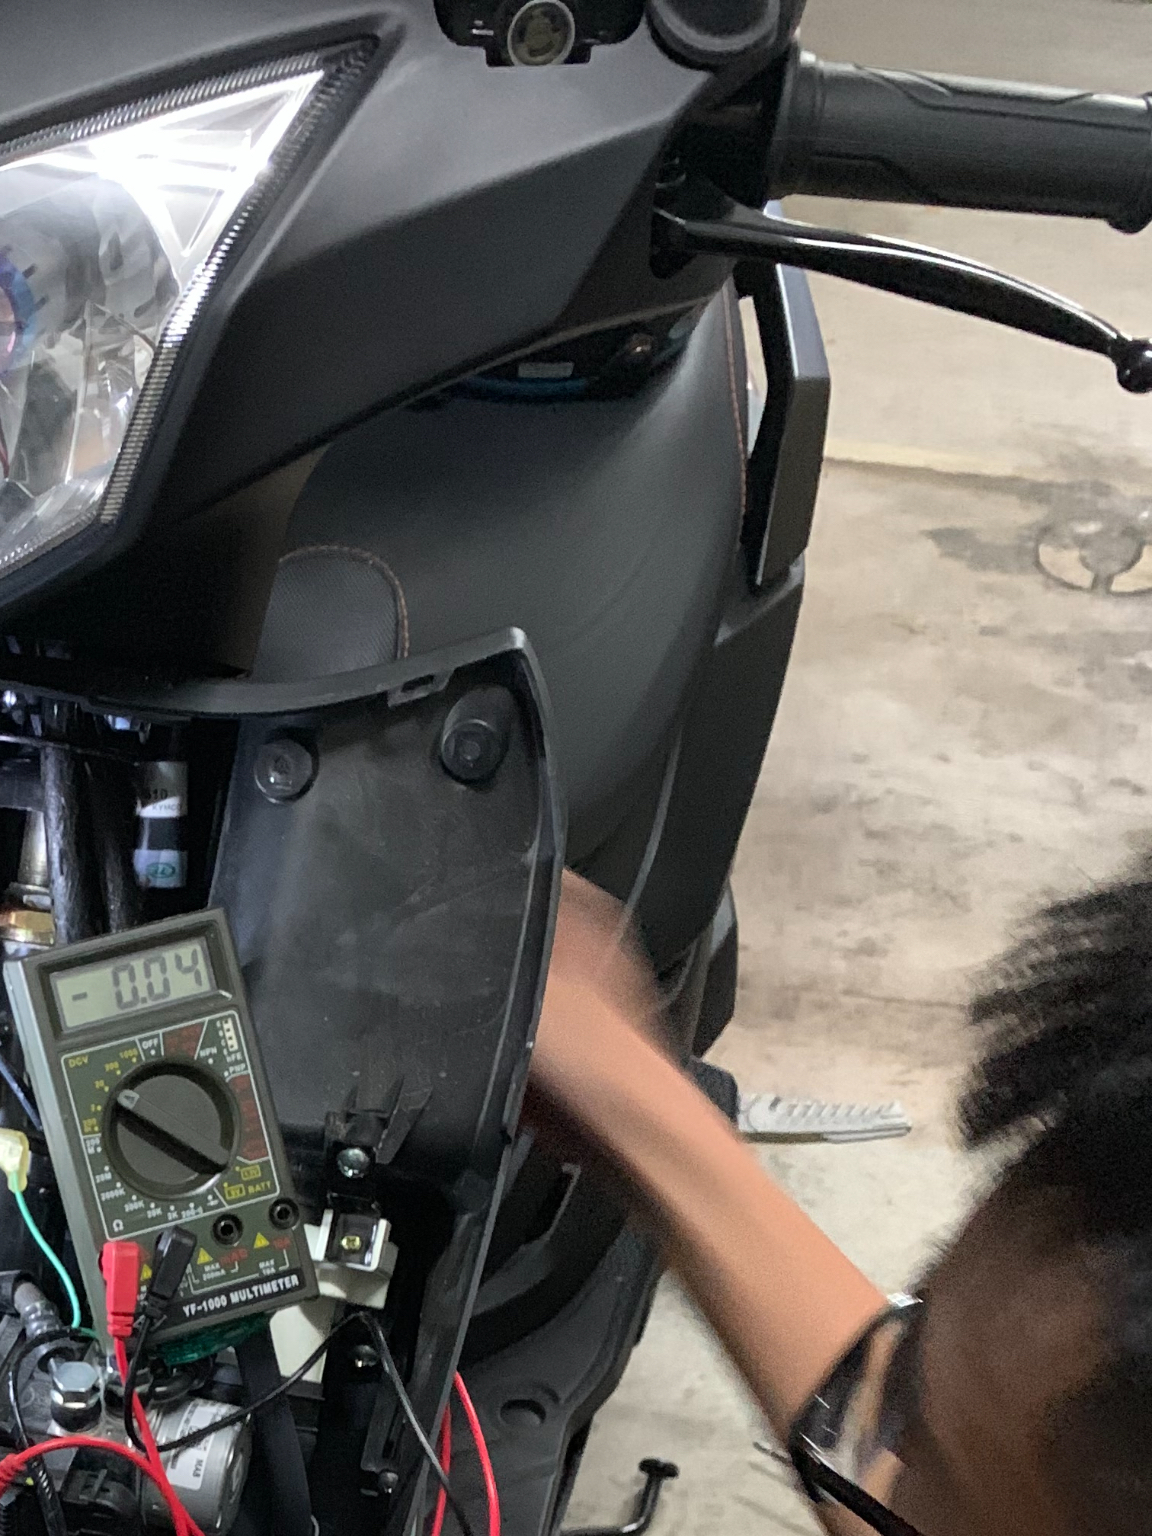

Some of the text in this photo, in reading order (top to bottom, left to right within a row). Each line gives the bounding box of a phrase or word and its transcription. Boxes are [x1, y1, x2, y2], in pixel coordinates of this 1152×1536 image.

[142, 1038, 159, 1050] OFF
[199, 1046, 218, 1058] NPN
[68, 1055, 88, 1069] DCV
[247, 1180, 271, 1195] BATT
[182, 1274, 300, 1319] YF-1000 MULTIMETER
